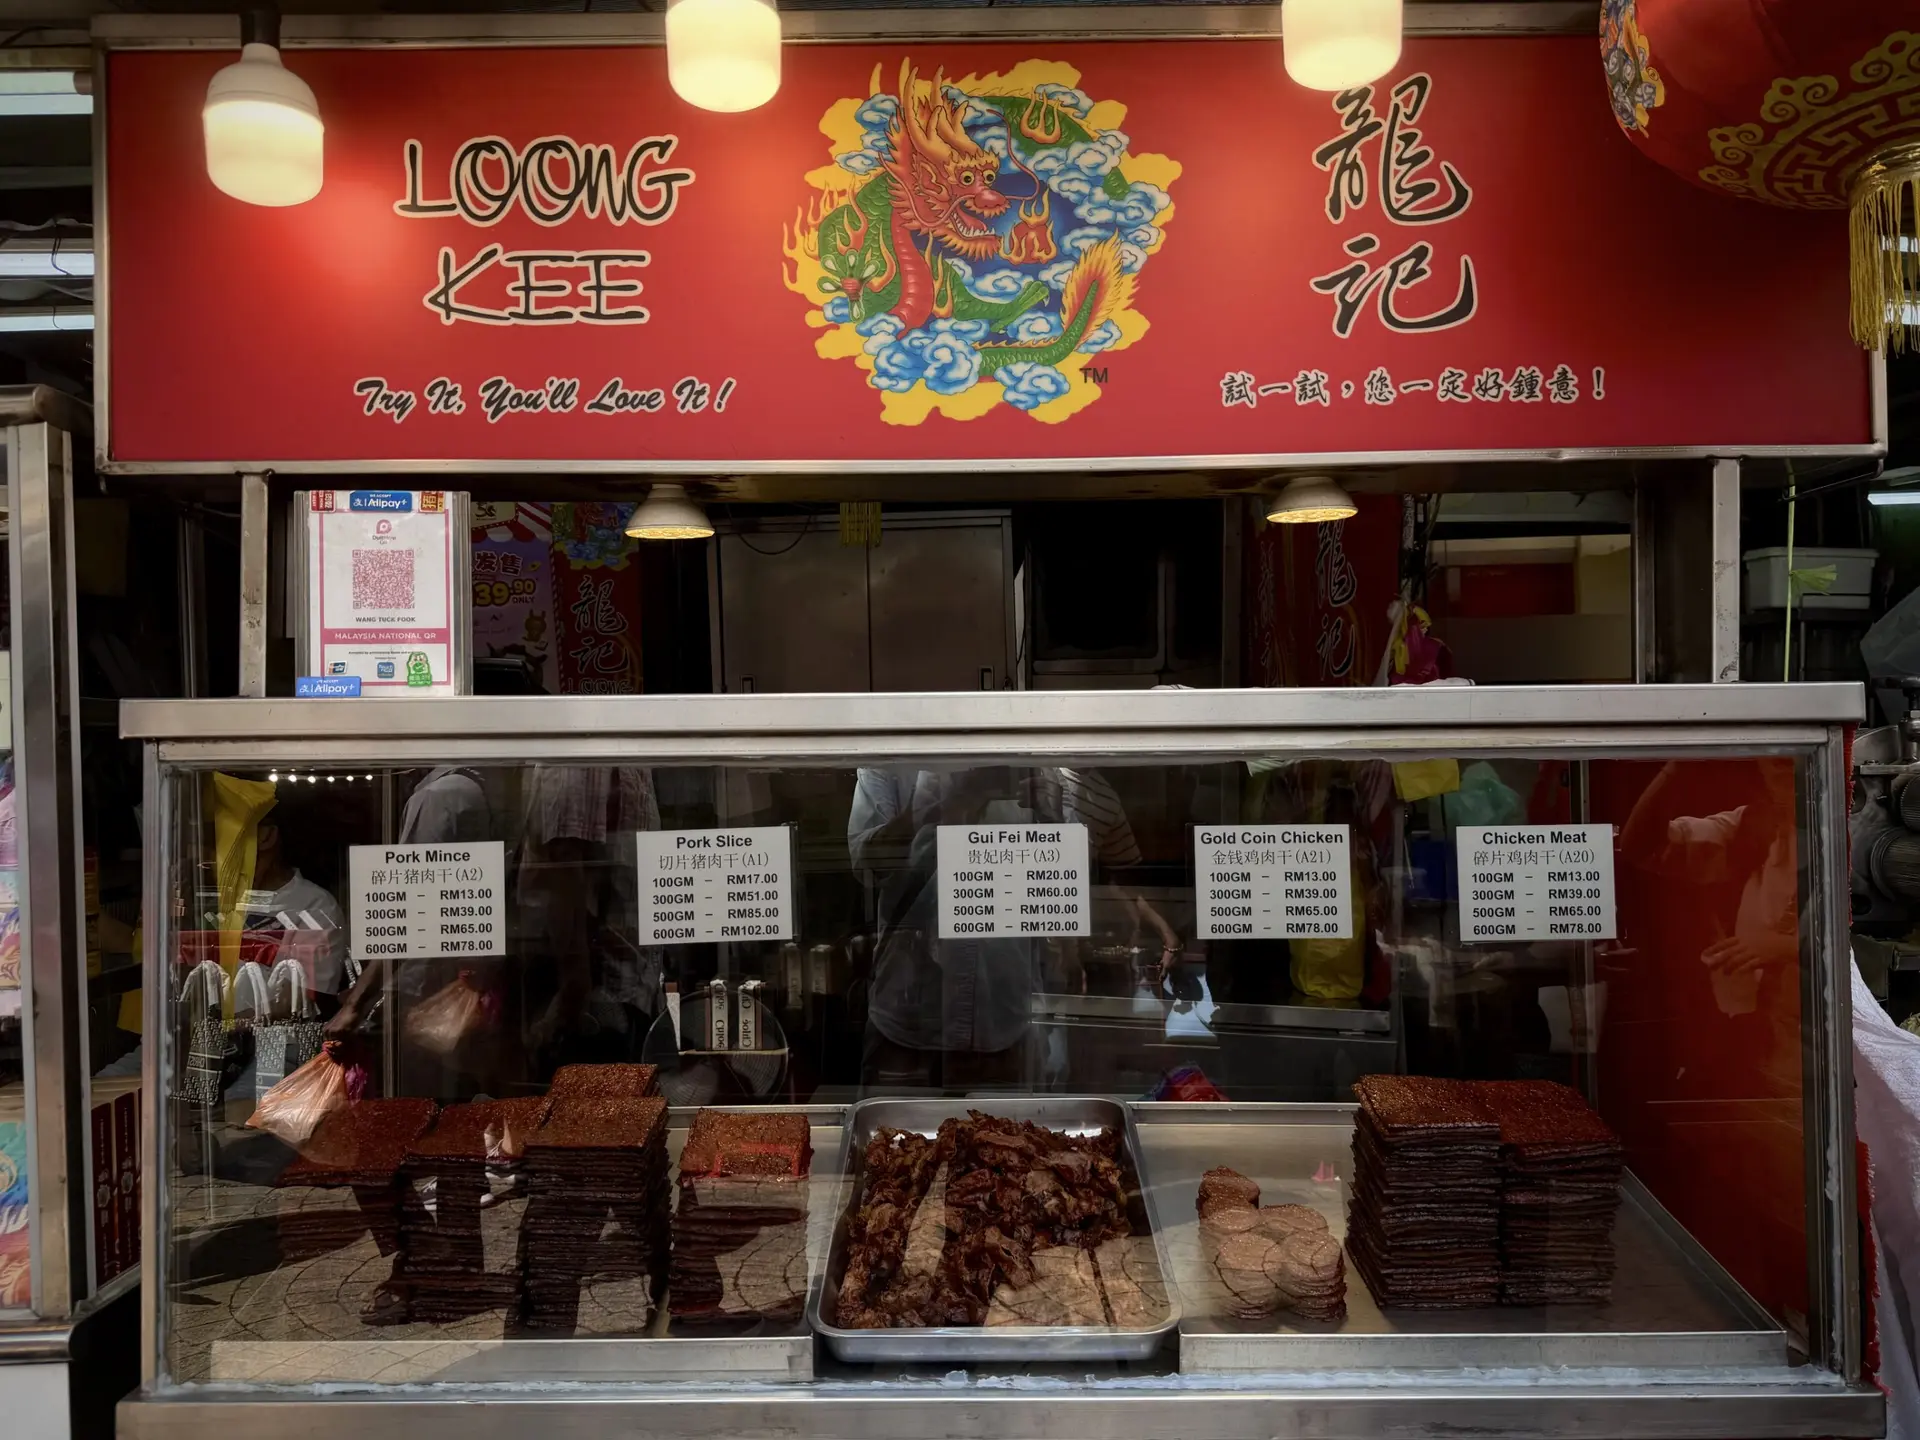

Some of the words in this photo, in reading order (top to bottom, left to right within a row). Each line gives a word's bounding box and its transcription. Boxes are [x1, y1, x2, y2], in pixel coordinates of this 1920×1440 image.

[394, 134, 695, 226] LOONG
[1310, 72, 1478, 338] 龍記
[424, 243, 650, 325] KEE
[1079, 367, 1108, 383] TM
[354, 377, 416, 422] Try
[424, 377, 465, 414] It,
[479, 376, 579, 422] You'll
[584, 378, 665, 415] Love
[570, 574, 630, 674] 龍記
[677, 836, 711, 848] Pork
[716, 835, 752, 847] Slice
[968, 832, 993, 843] Gui
[999, 831, 1020, 843] Fei
[1026, 831, 1061, 842] Meat
[1201, 832, 1236, 844] Gold
[1242, 832, 1275, 844] Coin
[1281, 831, 1343, 843] Chicken
[1483, 832, 1545, 844] Chicken
[1551, 831, 1587, 843] Meat
[386, 851, 420, 863] Pork
[426, 850, 470, 862] Mince
[653, 877, 693, 887] 100GM
[727, 874, 777, 884] RM17.00
[954, 871, 993, 881] 100GM
[1027, 870, 1077, 880] RM20.00
[1210, 872, 1250, 882] 100GM
[1285, 871, 1336, 881] RM13.00
[1472, 873, 1513, 883] 100GM
[1548, 871, 1599, 881] RM13.00
[366, 892, 406, 902] 100GM
[440, 889, 492, 900] RM13.00
[653, 894, 694, 905] 300GM
[728, 891, 778, 901] RM51.00
[954, 888, 993, 898] 300GM
[1027, 887, 1077, 897] RM60.00
[1210, 889, 1251, 899] 300GM
[1285, 889, 1336, 898] RM39.00
[1473, 890, 1514, 900] 300GM
[1549, 888, 1600, 899] RM39.00
[365, 909, 406, 919] 300GM
[441, 906, 492, 917] RM39.00
[654, 911, 694, 922] 500GM
[728, 908, 778, 919] RM85.00
[954, 905, 994, 915] 500GM
[1021, 904, 1077, 914] RM100.00
[1211, 907, 1251, 916] 500GM
[1286, 906, 1337, 916] RM65.00
[1473, 907, 1514, 917] 500GM
[1550, 906, 1601, 916] RM65.00
[366, 926, 406, 937] 500GM
[441, 923, 492, 934] RM65.00
[654, 928, 694, 939] 600GM
[722, 925, 779, 936] RM102.00
[954, 922, 994, 932] 600GM
[1021, 921, 1078, 931] RM120.00
[1211, 924, 1252, 933] 600GM
[1287, 923, 1338, 933] RM78.00
[1474, 925, 1515, 935] 600GM
[1550, 923, 1601, 933] RM78.00
[366, 943, 407, 954] 600GM
[441, 940, 492, 951] RM78.00
